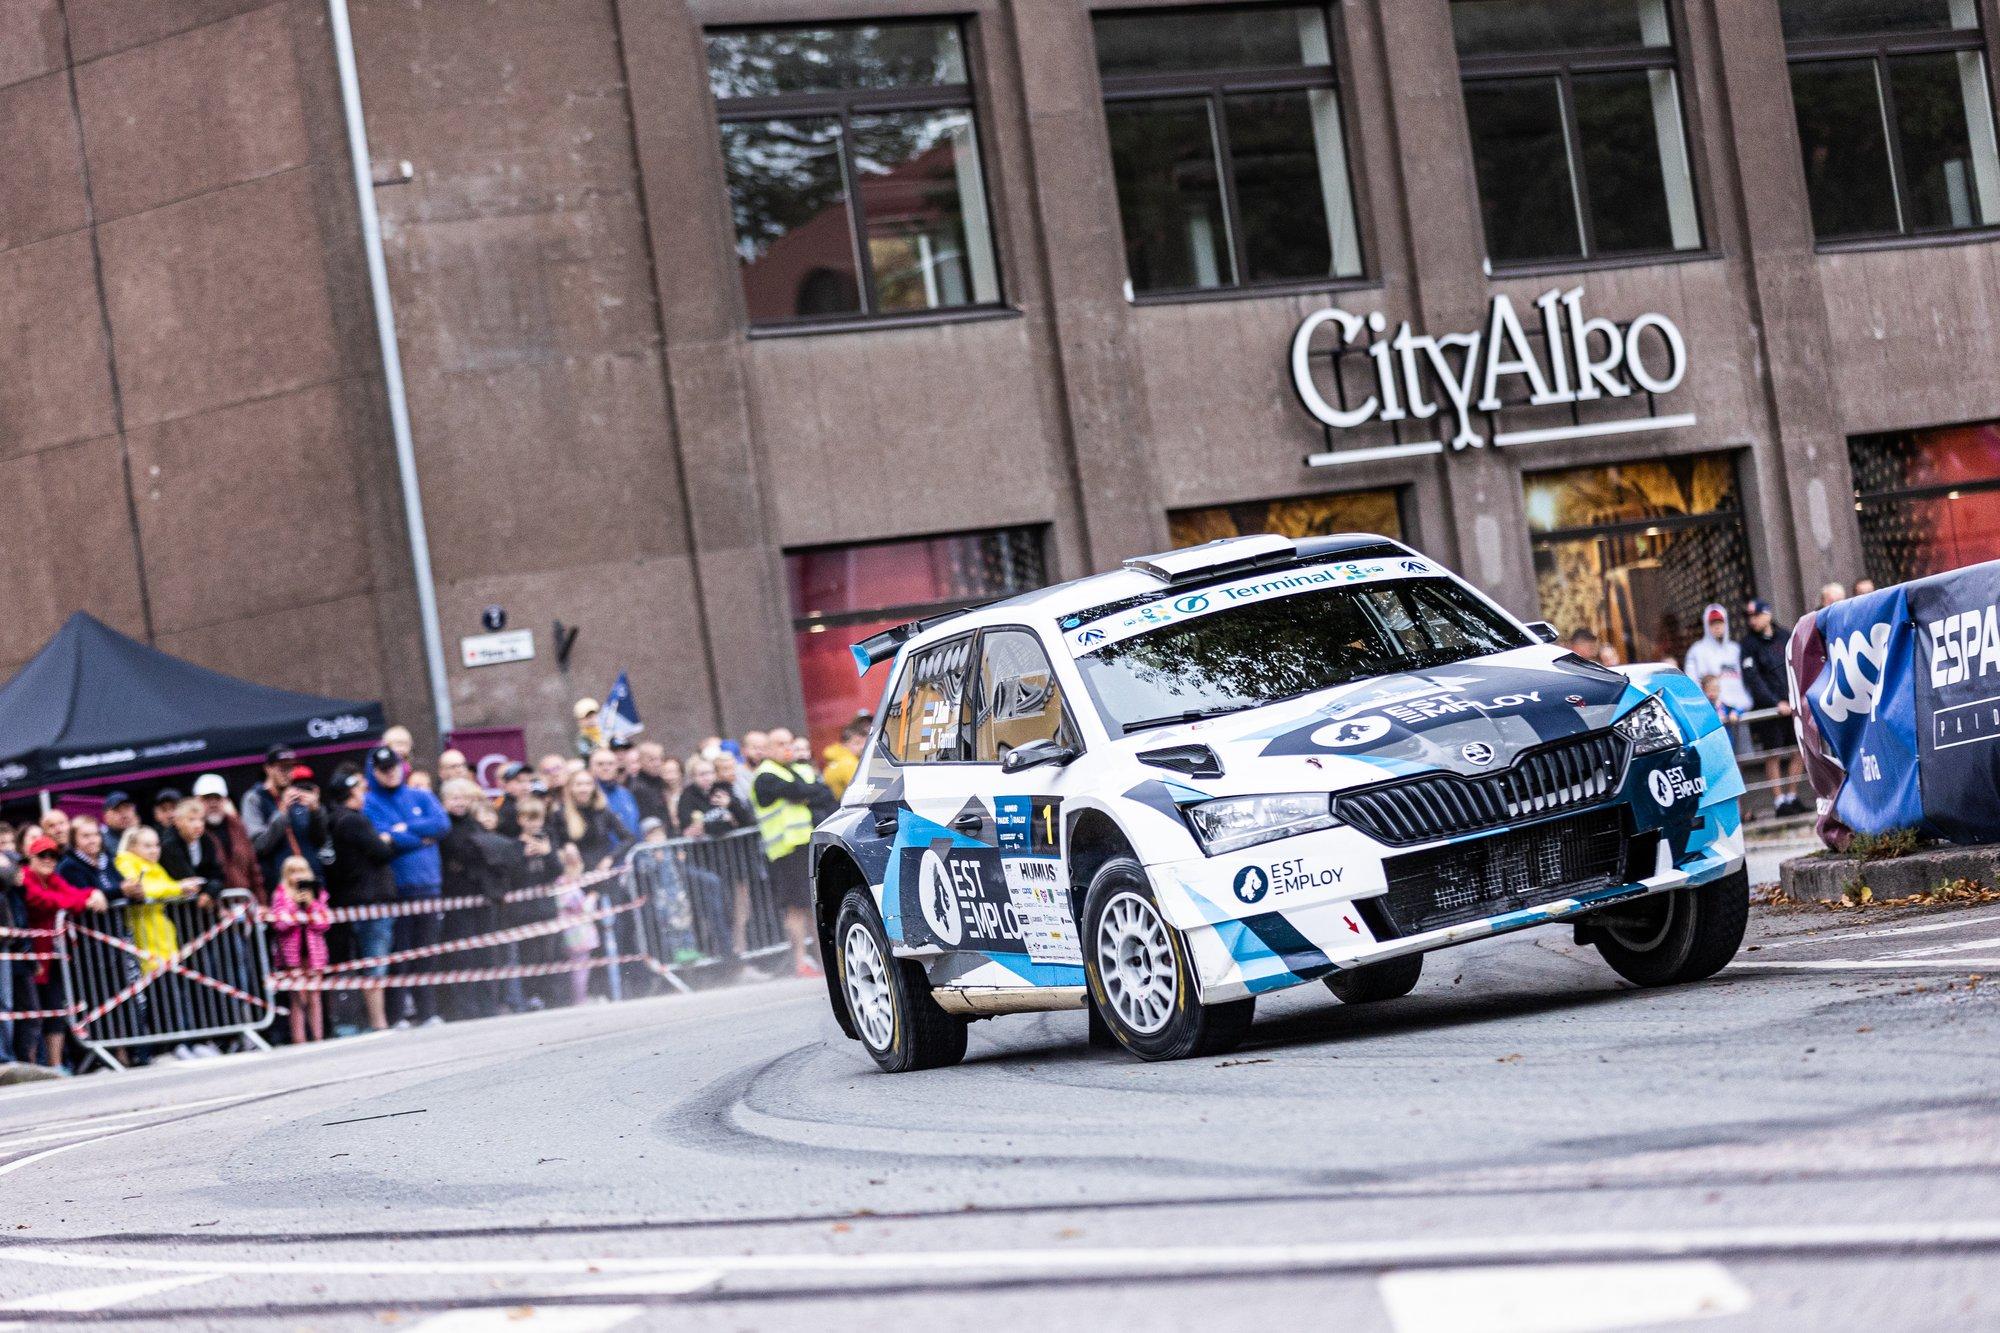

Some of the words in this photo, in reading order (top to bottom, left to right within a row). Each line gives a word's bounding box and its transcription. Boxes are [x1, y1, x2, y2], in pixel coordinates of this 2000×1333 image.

[1292, 286, 1687, 450] CityAlko
[1219, 570, 1335, 602] Terminal
[1382, 694, 1455, 717] EST
[1400, 691, 1541, 724] EMPLOY
[1665, 766, 1686, 784] EST
[1042, 804, 1053, 845] 1
[950, 860, 985, 898] EST
[1019, 862, 1056, 881] HUMUS
[1271, 858, 1304, 879] EST
[1273, 867, 1343, 895] EMPLOY
